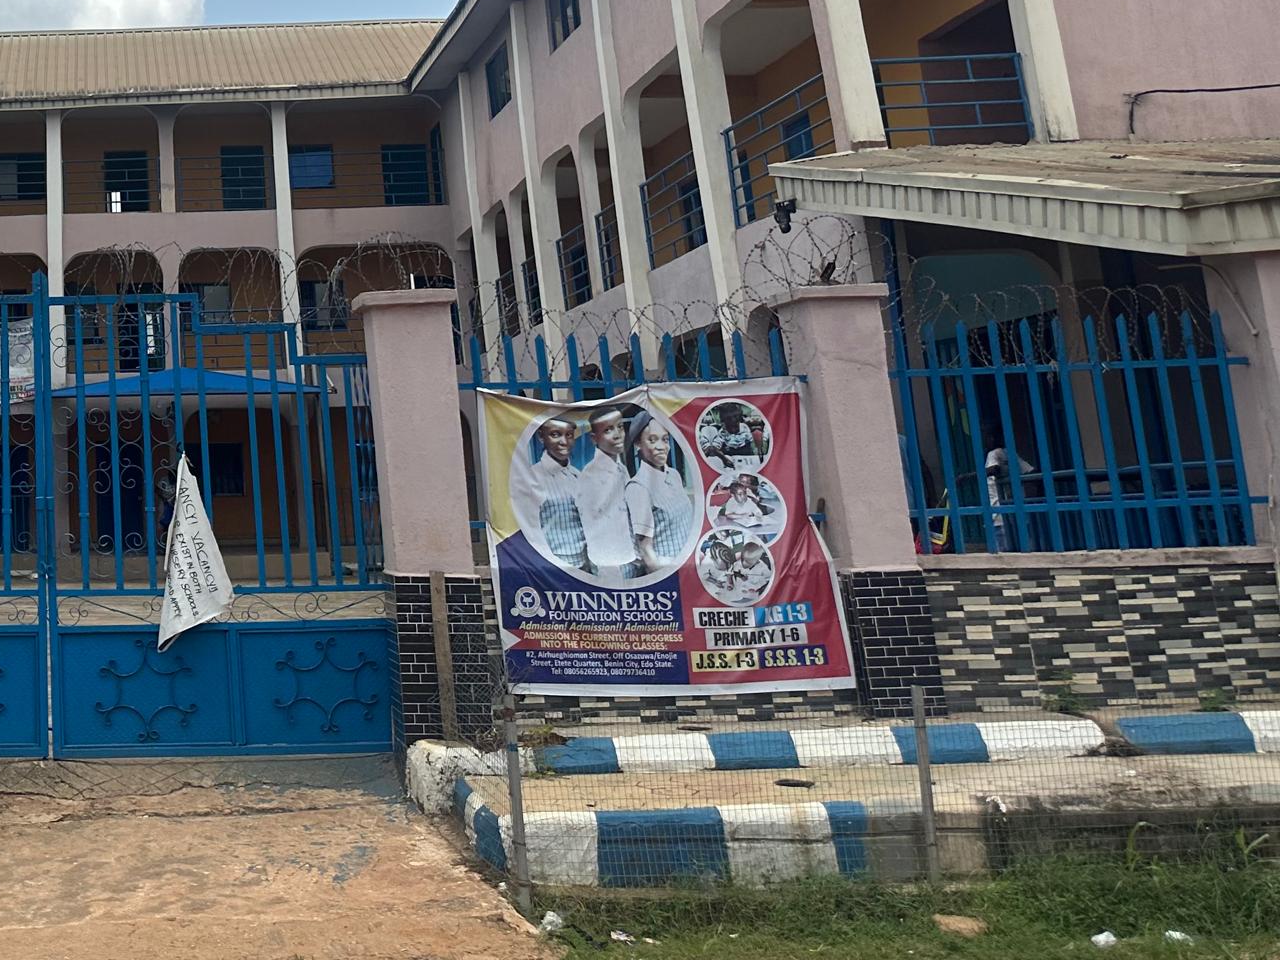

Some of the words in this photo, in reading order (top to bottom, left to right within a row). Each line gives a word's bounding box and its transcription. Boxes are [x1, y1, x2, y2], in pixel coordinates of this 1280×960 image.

[187, 562, 194, 570] IN
[189, 571, 202, 594] BOTH
[181, 583, 199, 617] SCHOOLS
[545, 591, 677, 611] WINNERS'
[549, 611, 620, 621] FOUNDATION
[624, 611, 673, 621] SCHOOLS
[698, 610, 749, 626] CRECHE
[765, 606, 784, 623] KG
[786, 604, 807, 621] 1-3
[520, 621, 567, 630] Admission!
[570, 622, 622, 631] Admission!!
[624, 622, 678, 631] Admission!!!
[524, 632, 570, 640] ADMISSION
[572, 632, 580, 640] IS
[582, 633, 627, 641] CURRENTLY
[641, 634, 683, 642] PROGRESS
[714, 629, 775, 646] PRIMARY
[780, 627, 800, 641] 1-6
[541, 640, 561, 648] INTO
[580, 641, 630, 650] FOLLOWING
[632, 642, 668, 650] CLASSES:
[589, 652, 611, 660] Street,
[624, 652, 677, 661] Osazuwa/Enojie
[696, 653, 732, 669] J.S.S.
[734, 652, 755, 667] 1-3
[765, 650, 800, 666] S.S.S.
[803, 648, 824, 665] 1-3
[572, 660, 603, 668] Quarters,
[625, 660, 640, 668] City,
